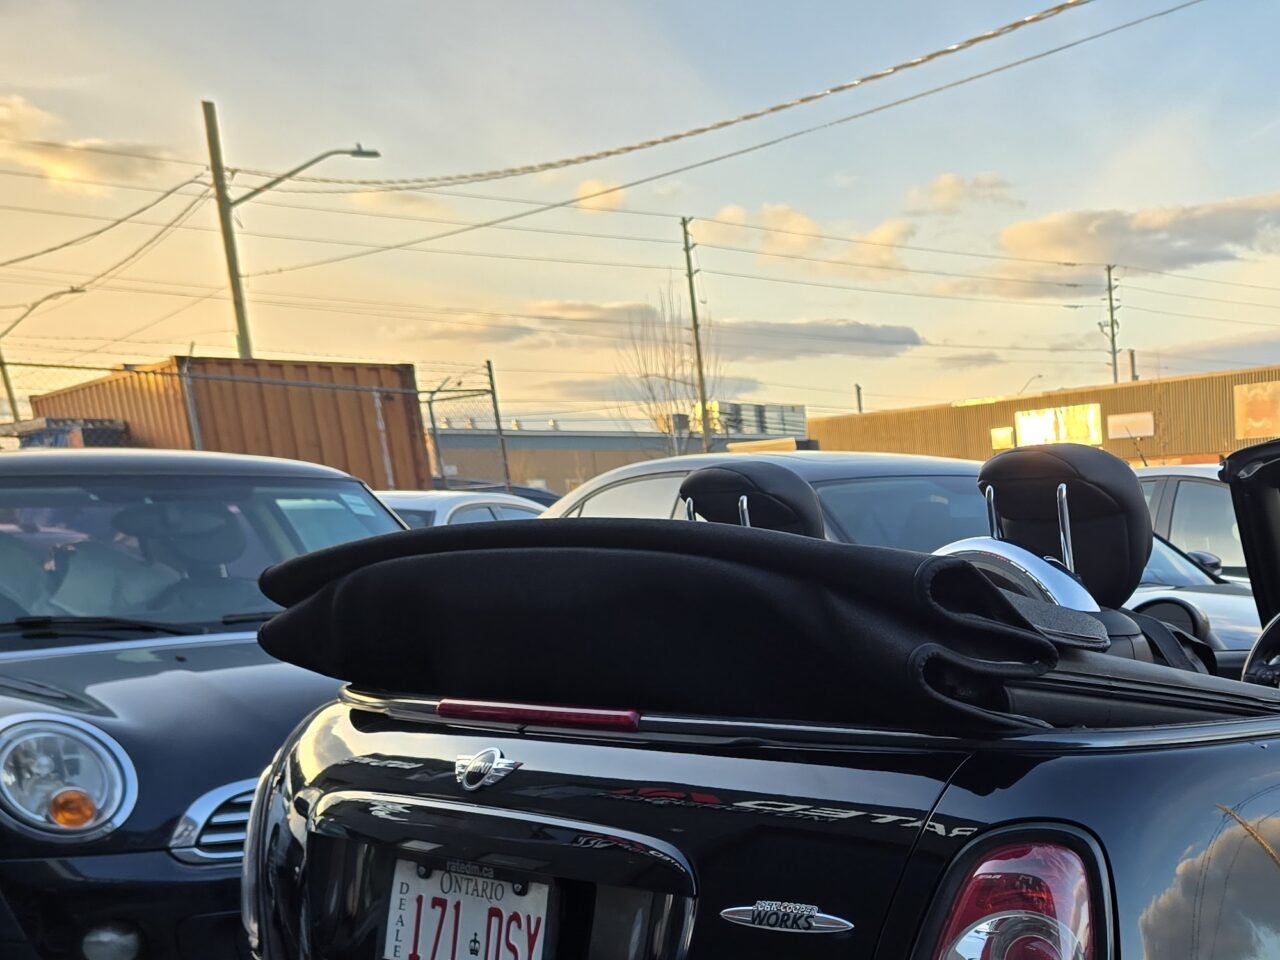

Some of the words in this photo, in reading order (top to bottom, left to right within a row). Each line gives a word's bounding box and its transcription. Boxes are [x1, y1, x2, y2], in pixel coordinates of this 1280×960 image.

[446, 860, 494, 878] ratedm.ca
[440, 871, 505, 903] ONTARIO
[780, 901, 819, 916] COOPER
[751, 910, 815, 931] WORKS
